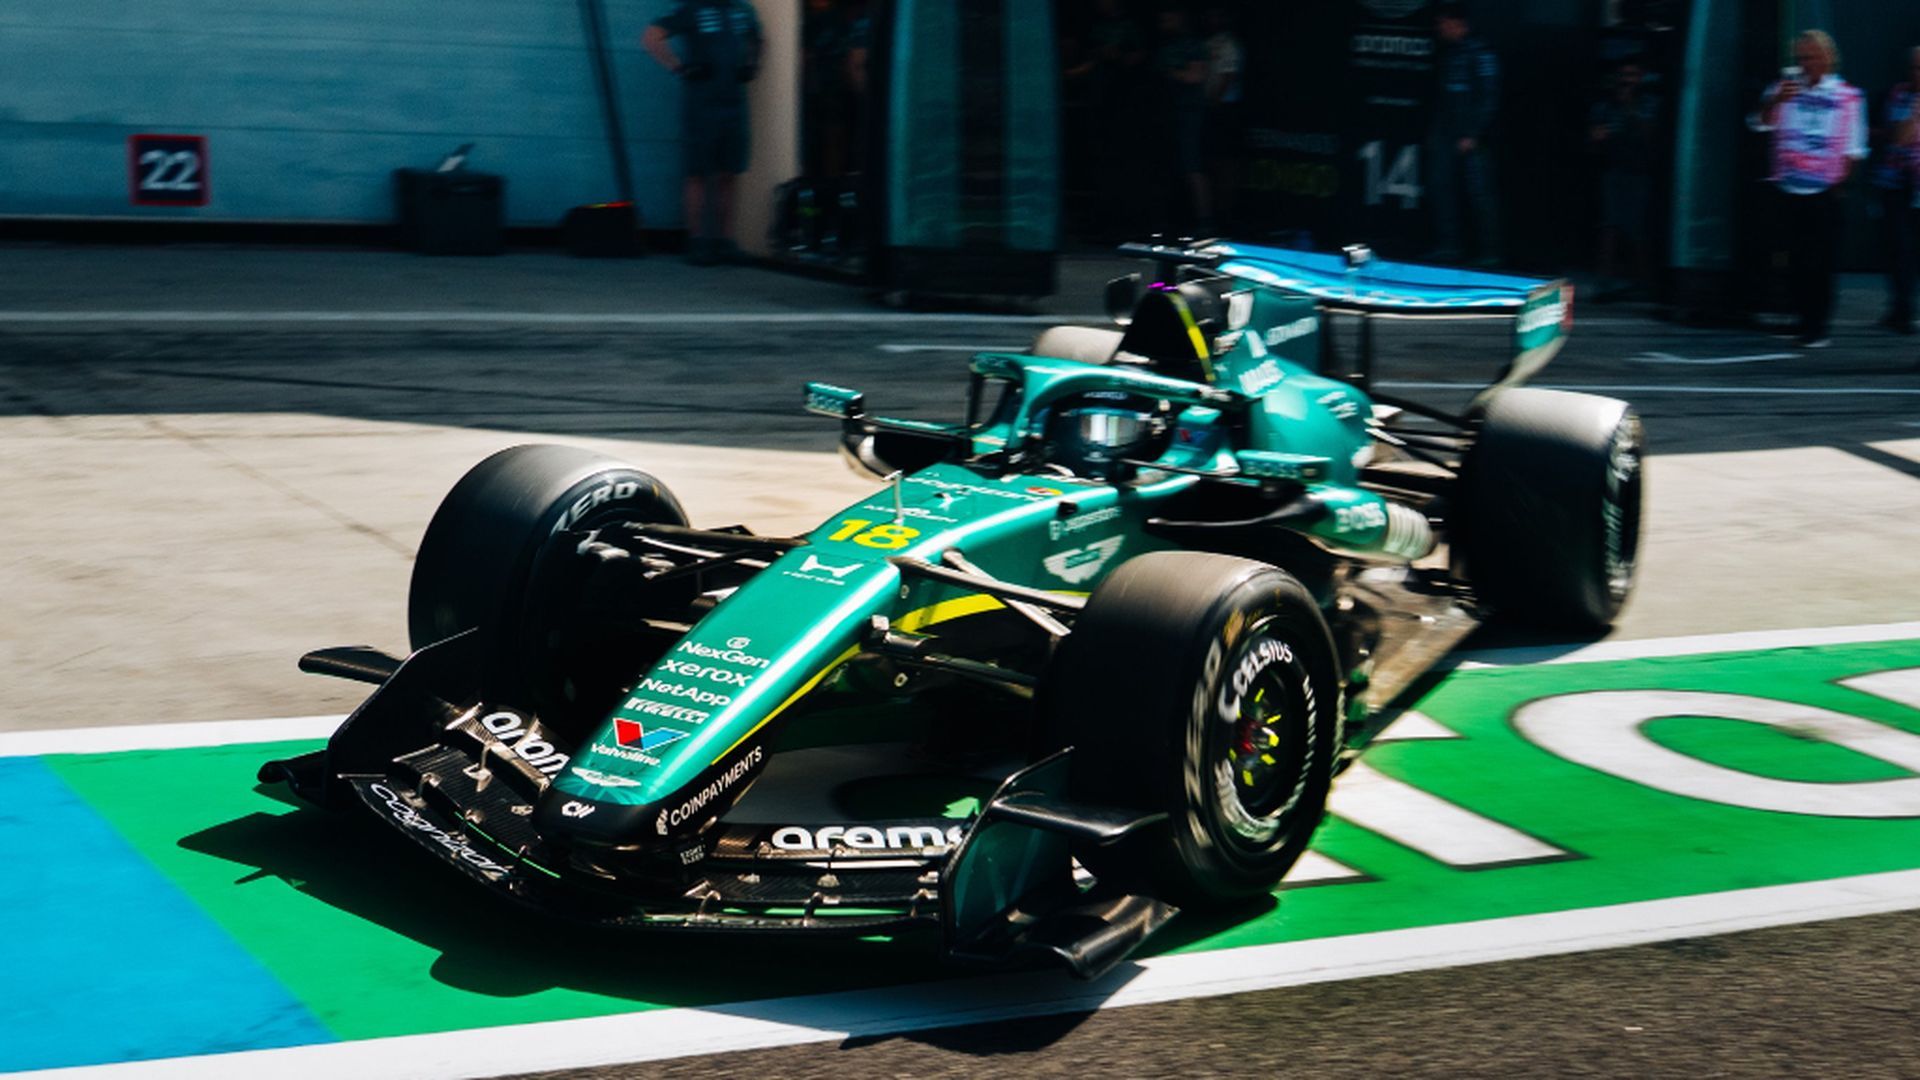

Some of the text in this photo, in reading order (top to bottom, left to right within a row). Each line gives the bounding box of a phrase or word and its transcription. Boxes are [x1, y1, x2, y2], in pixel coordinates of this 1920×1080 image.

[139, 149, 200, 191] 22
[1360, 139, 1423, 210] 14
[828, 518, 921, 550] 18
[676, 640, 771, 669] NexGen
[657, 659, 753, 688] xerox
[637, 677, 732, 707] NetApp
[481, 711, 571, 781] aram
[590, 743, 661, 767] Valvoline
[670, 745, 763, 827] COINPAYMENTS
